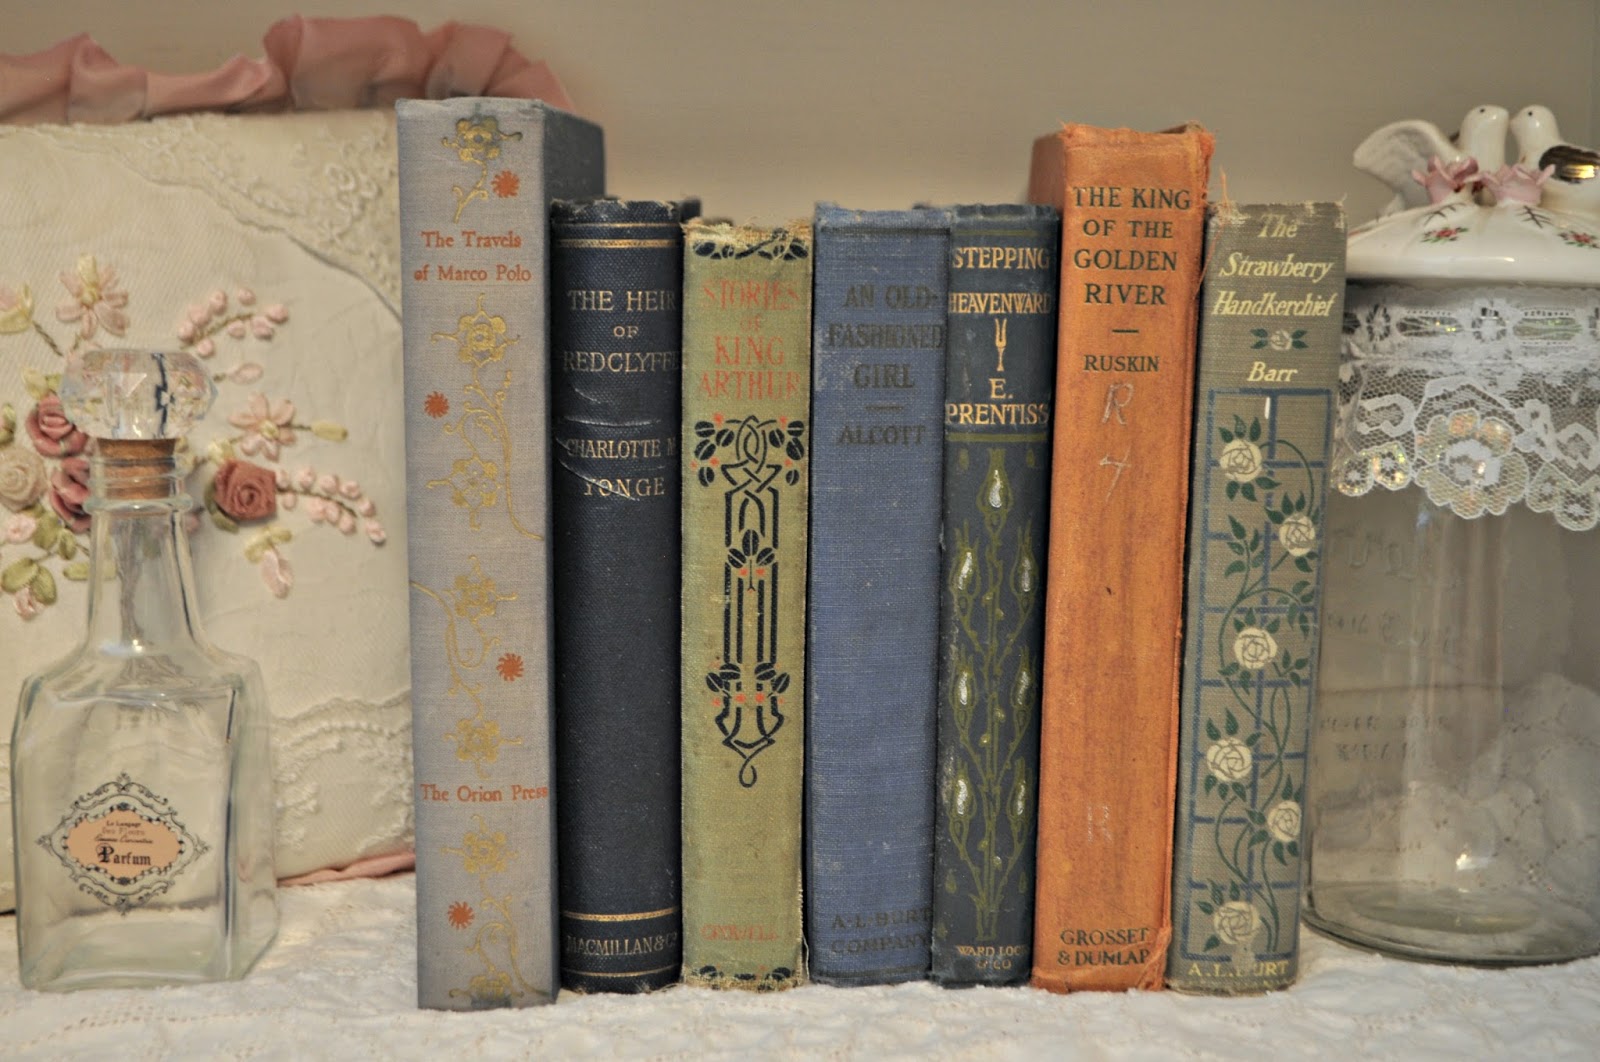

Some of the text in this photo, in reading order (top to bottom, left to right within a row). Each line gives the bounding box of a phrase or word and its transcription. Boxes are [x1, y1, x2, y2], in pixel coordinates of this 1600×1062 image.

[1073, 187, 1190, 210] THE KING
[1083, 219, 1173, 238] OF THE
[1257, 214, 1298, 238] The
[421, 231, 522, 248] The Travels
[952, 247, 1050, 269] STEPPING
[1074, 249, 1177, 271] GOLDEN
[1218, 252, 1334, 284] Strawberry
[414, 264, 531, 281] of Marco Polo
[567, 290, 676, 311] THE HEIR
[702, 279, 800, 311] STORIES
[843, 284, 874, 309] AN
[1085, 283, 1166, 305] RIVER
[1211, 290, 1338, 317] Handkerchief
[613, 326, 639, 338] OF
[828, 324, 944, 349] FASHIONED
[715, 336, 784, 367] KING
[1083, 354, 1160, 372] RUSKIN
[1247, 361, 1298, 382] Barr
[701, 370, 801, 401] ARTHUR
[854, 364, 915, 389] GIRL
[989, 378, 1014, 400] E.
[945, 403, 1049, 425] PRENTISS
[839, 425, 925, 446] ALCOTT
[566, 439, 661, 458] CHARLOTTE
[584, 477, 665, 497] YONGE
[420, 784, 548, 802] The Orion Press
[96, 842, 151, 866] Parfum
[1060, 928, 1150, 945] GROSSET
[956, 944, 995, 957] WARD
[1057, 949, 1150, 966] & DUNLAP
